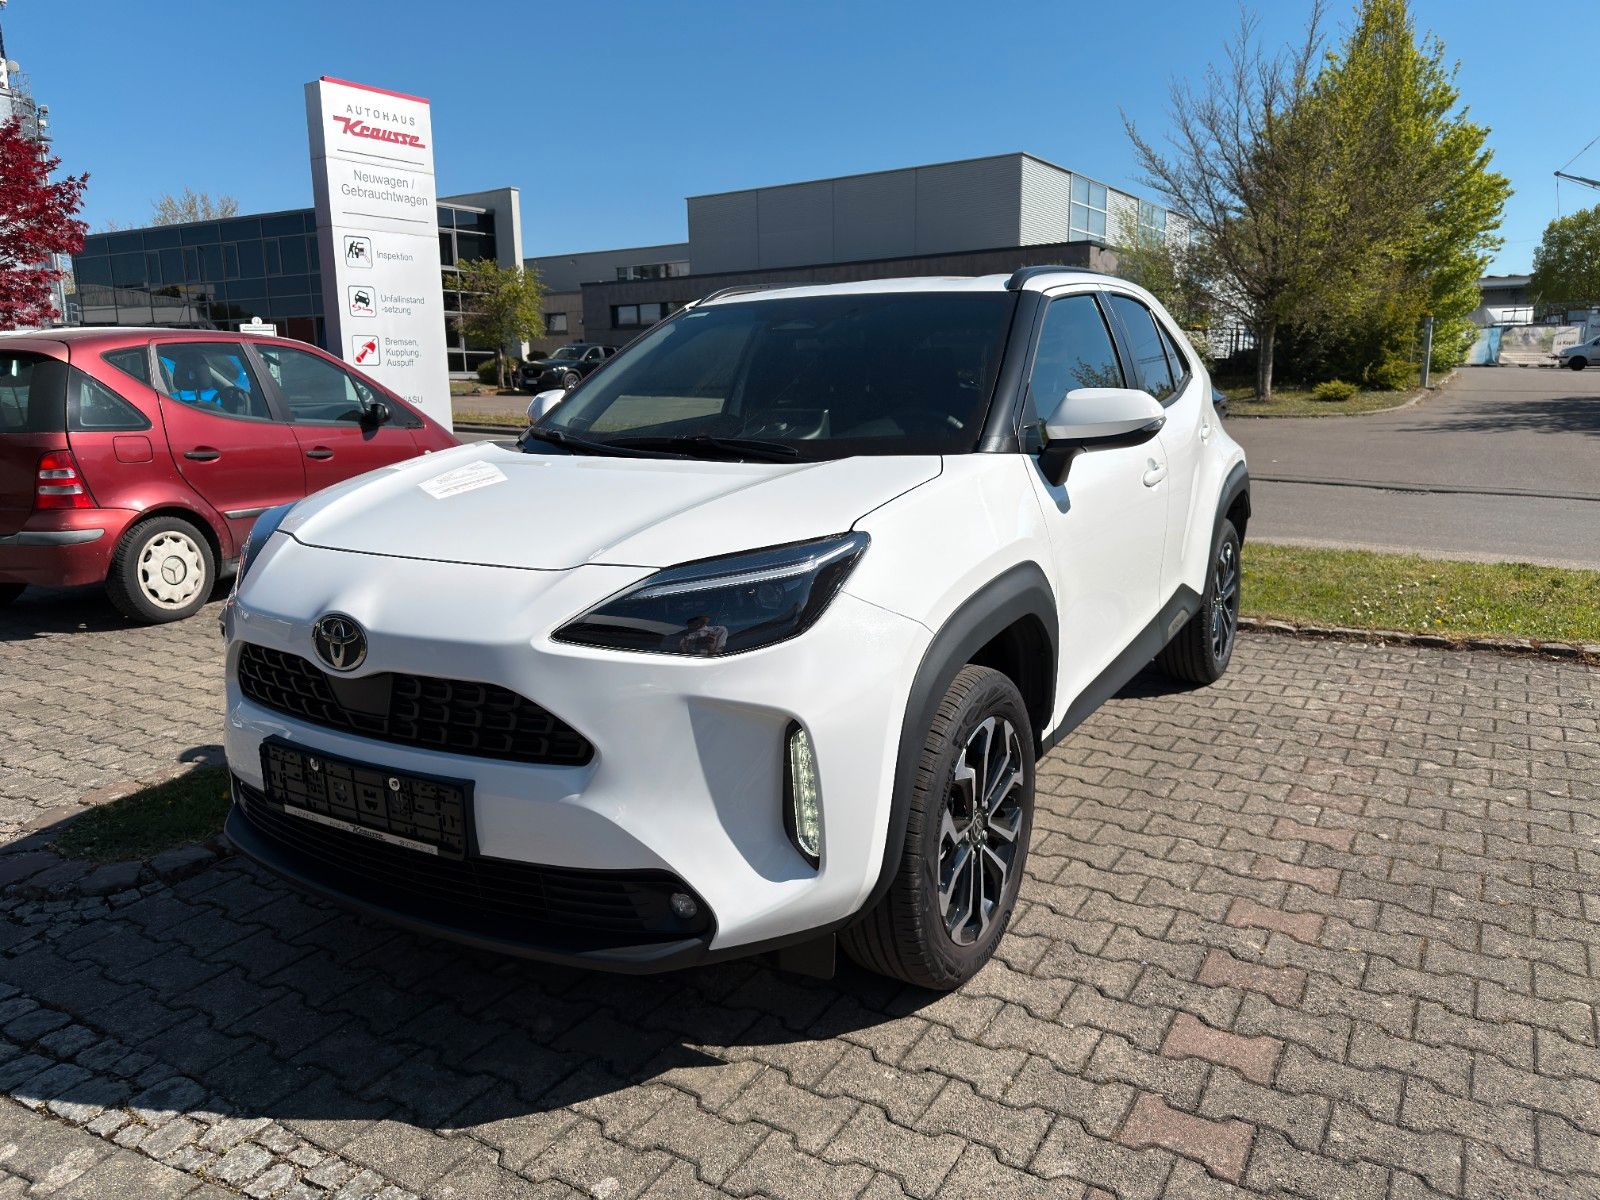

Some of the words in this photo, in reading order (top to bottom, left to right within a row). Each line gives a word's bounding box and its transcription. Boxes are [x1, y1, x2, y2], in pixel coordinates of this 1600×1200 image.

[346, 104, 416, 126] AUTOHAUS
[332, 114, 426, 149] Krausse
[353, 169, 409, 189] Neuwagen
[341, 183, 428, 207] Gebrauchtwagen
[376, 250, 413, 262] Inspektion
[380, 294, 425, 305] Unfallinstand
[386, 358, 415, 368] Auspuff
